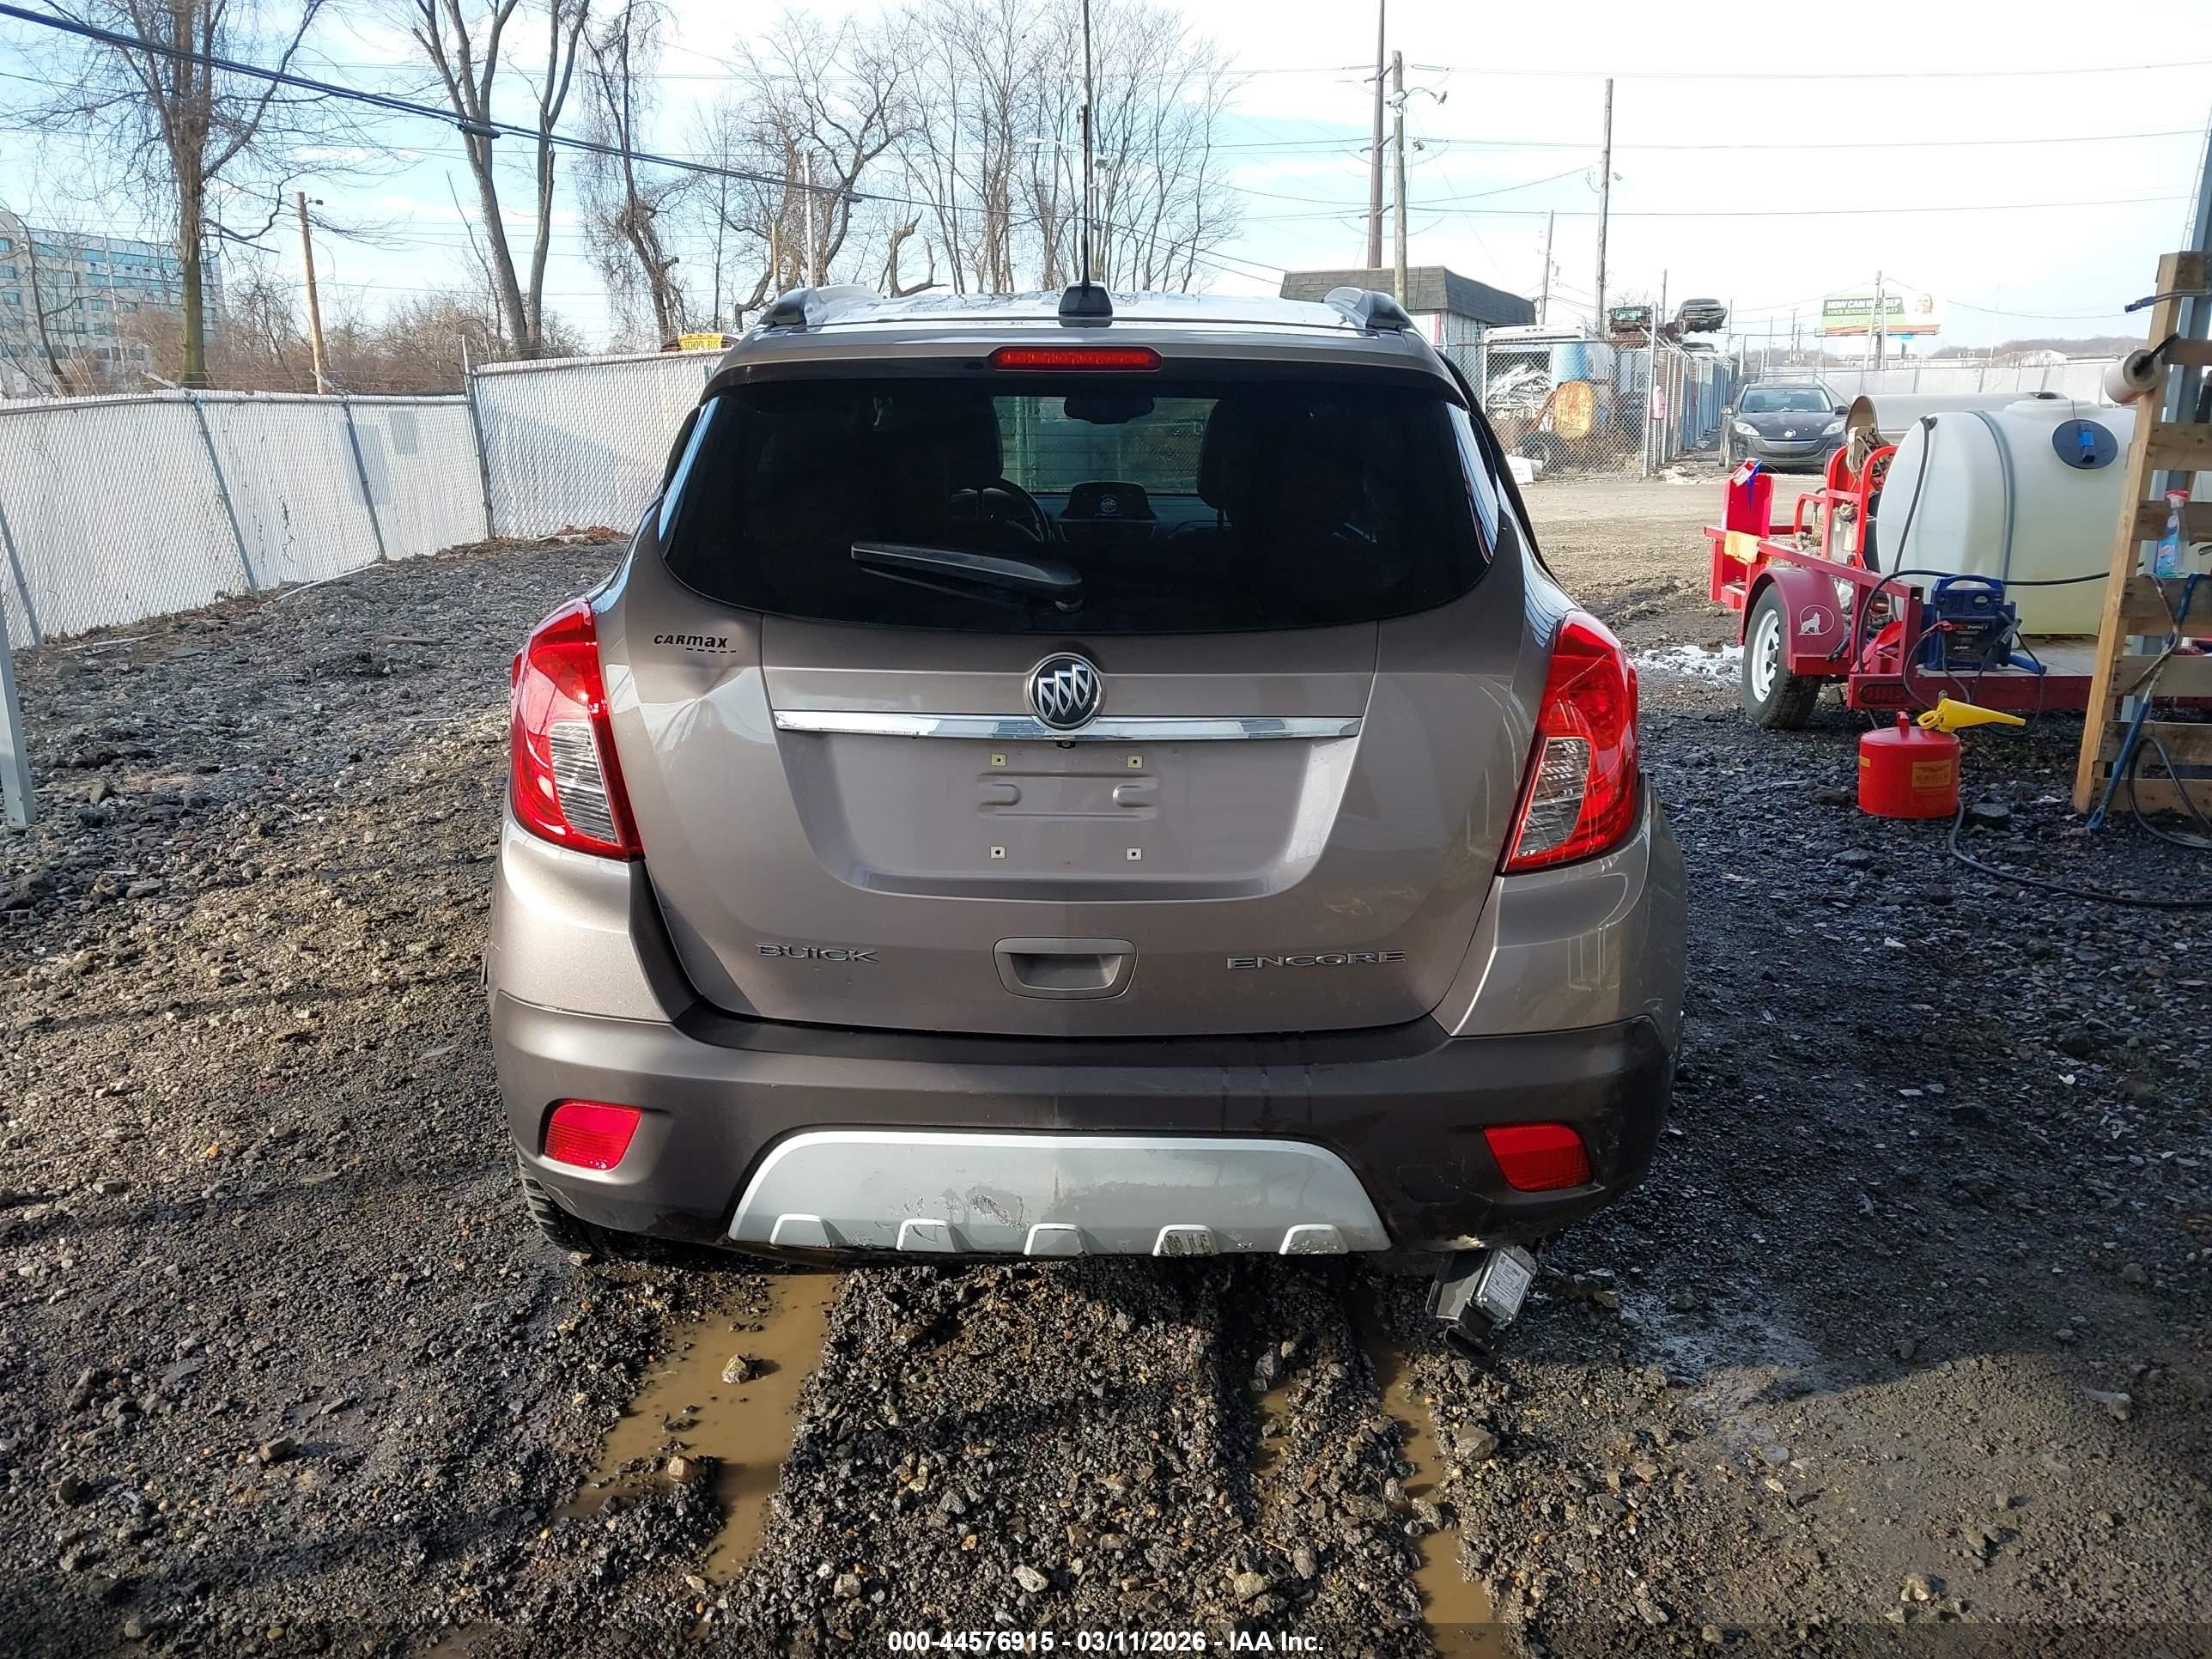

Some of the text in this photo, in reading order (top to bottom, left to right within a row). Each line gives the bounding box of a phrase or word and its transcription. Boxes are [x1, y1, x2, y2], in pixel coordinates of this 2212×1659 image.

[1826, 301, 1848, 309] HOW
[1848, 300, 1866, 308] CAN
[684, 339, 719, 351] SCHOOL BUS
[756, 943, 879, 963] BUICK
[1226, 949, 1407, 970] ENCORE
